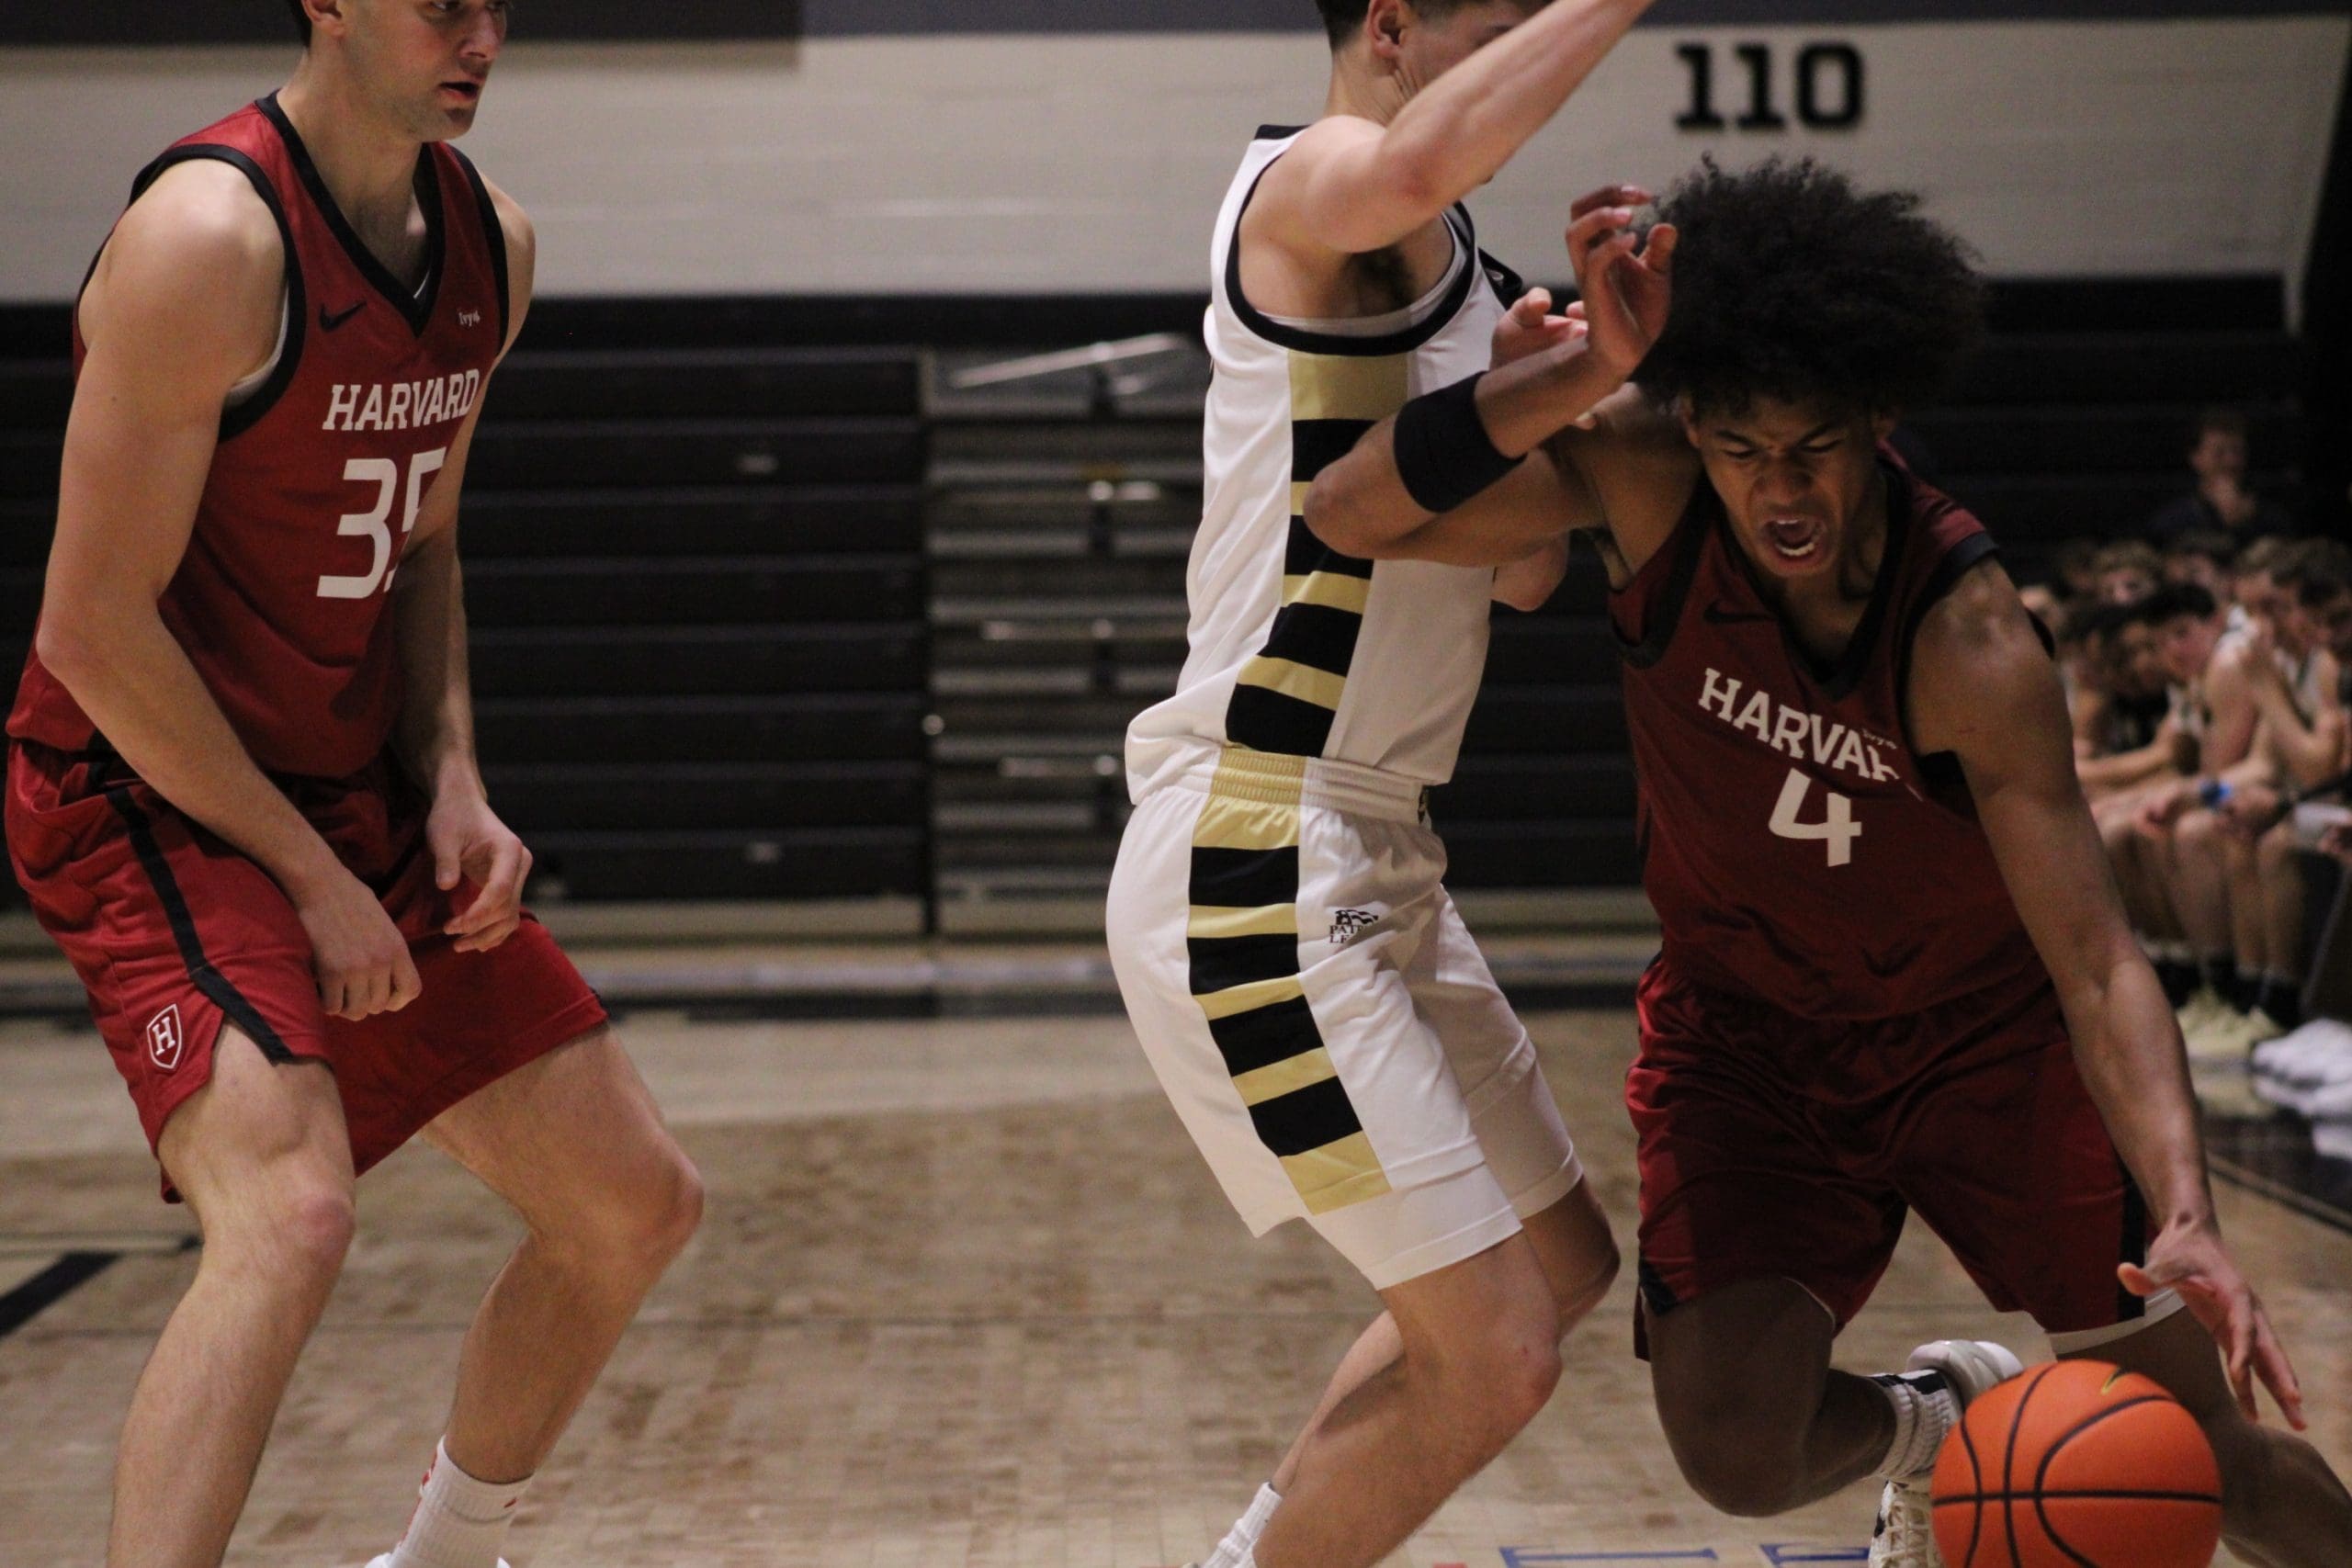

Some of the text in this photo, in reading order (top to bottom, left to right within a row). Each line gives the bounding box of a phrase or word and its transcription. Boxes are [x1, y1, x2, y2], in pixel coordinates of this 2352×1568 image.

[1676, 42, 1863, 130] 110
[322, 368, 481, 432] HARVARD
[1768, 766, 1863, 867] 4
[152, 1016, 176, 1056] H
